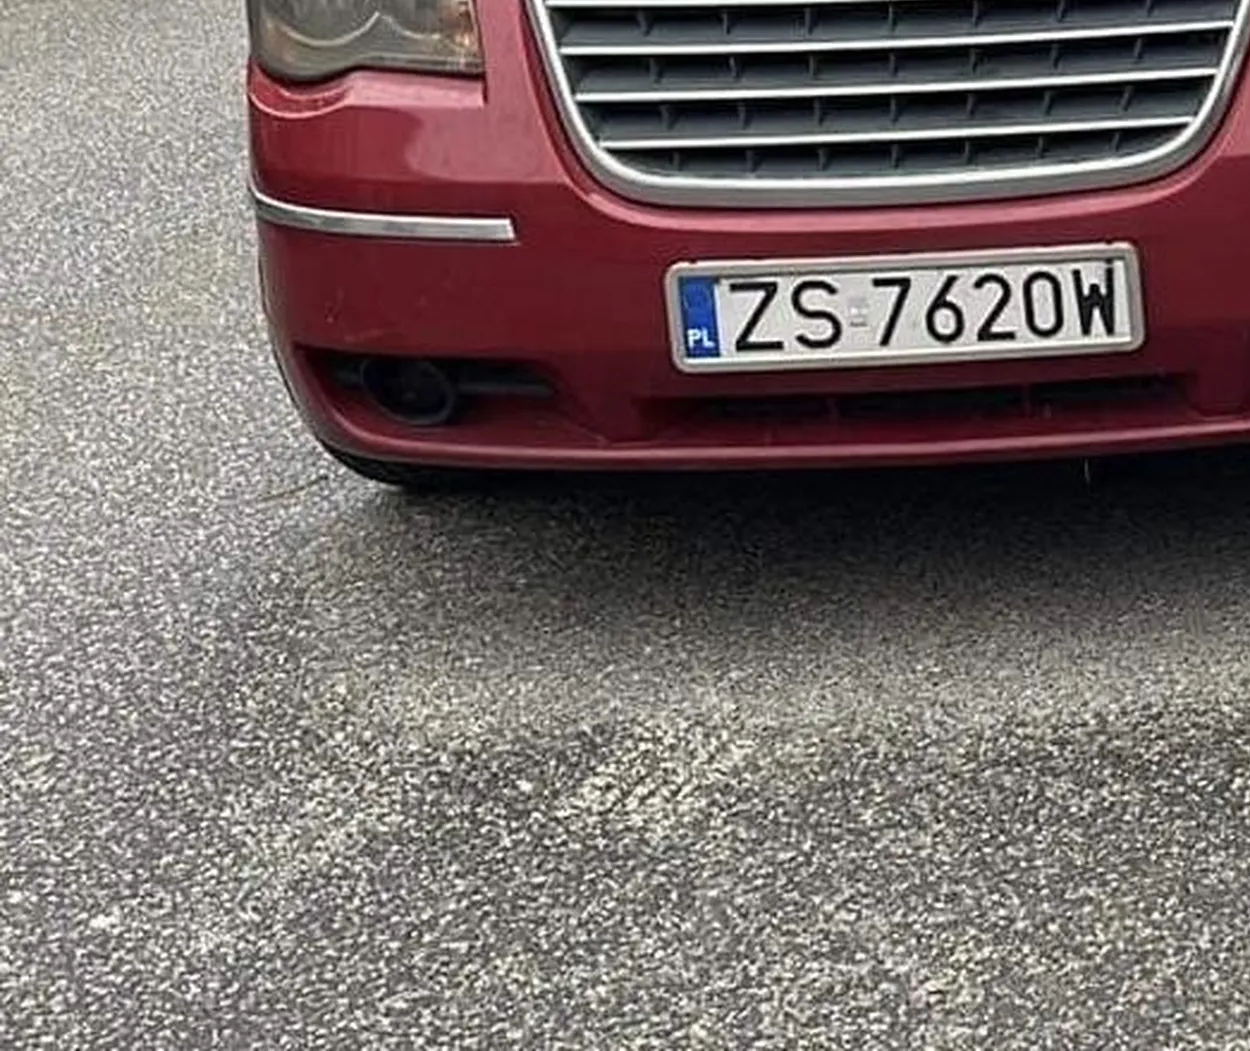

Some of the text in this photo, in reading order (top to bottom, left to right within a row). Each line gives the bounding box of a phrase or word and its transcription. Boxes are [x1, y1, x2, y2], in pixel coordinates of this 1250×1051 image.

[728, 265, 1116, 353] ZS 7620W
[687, 329, 715, 347] PL
